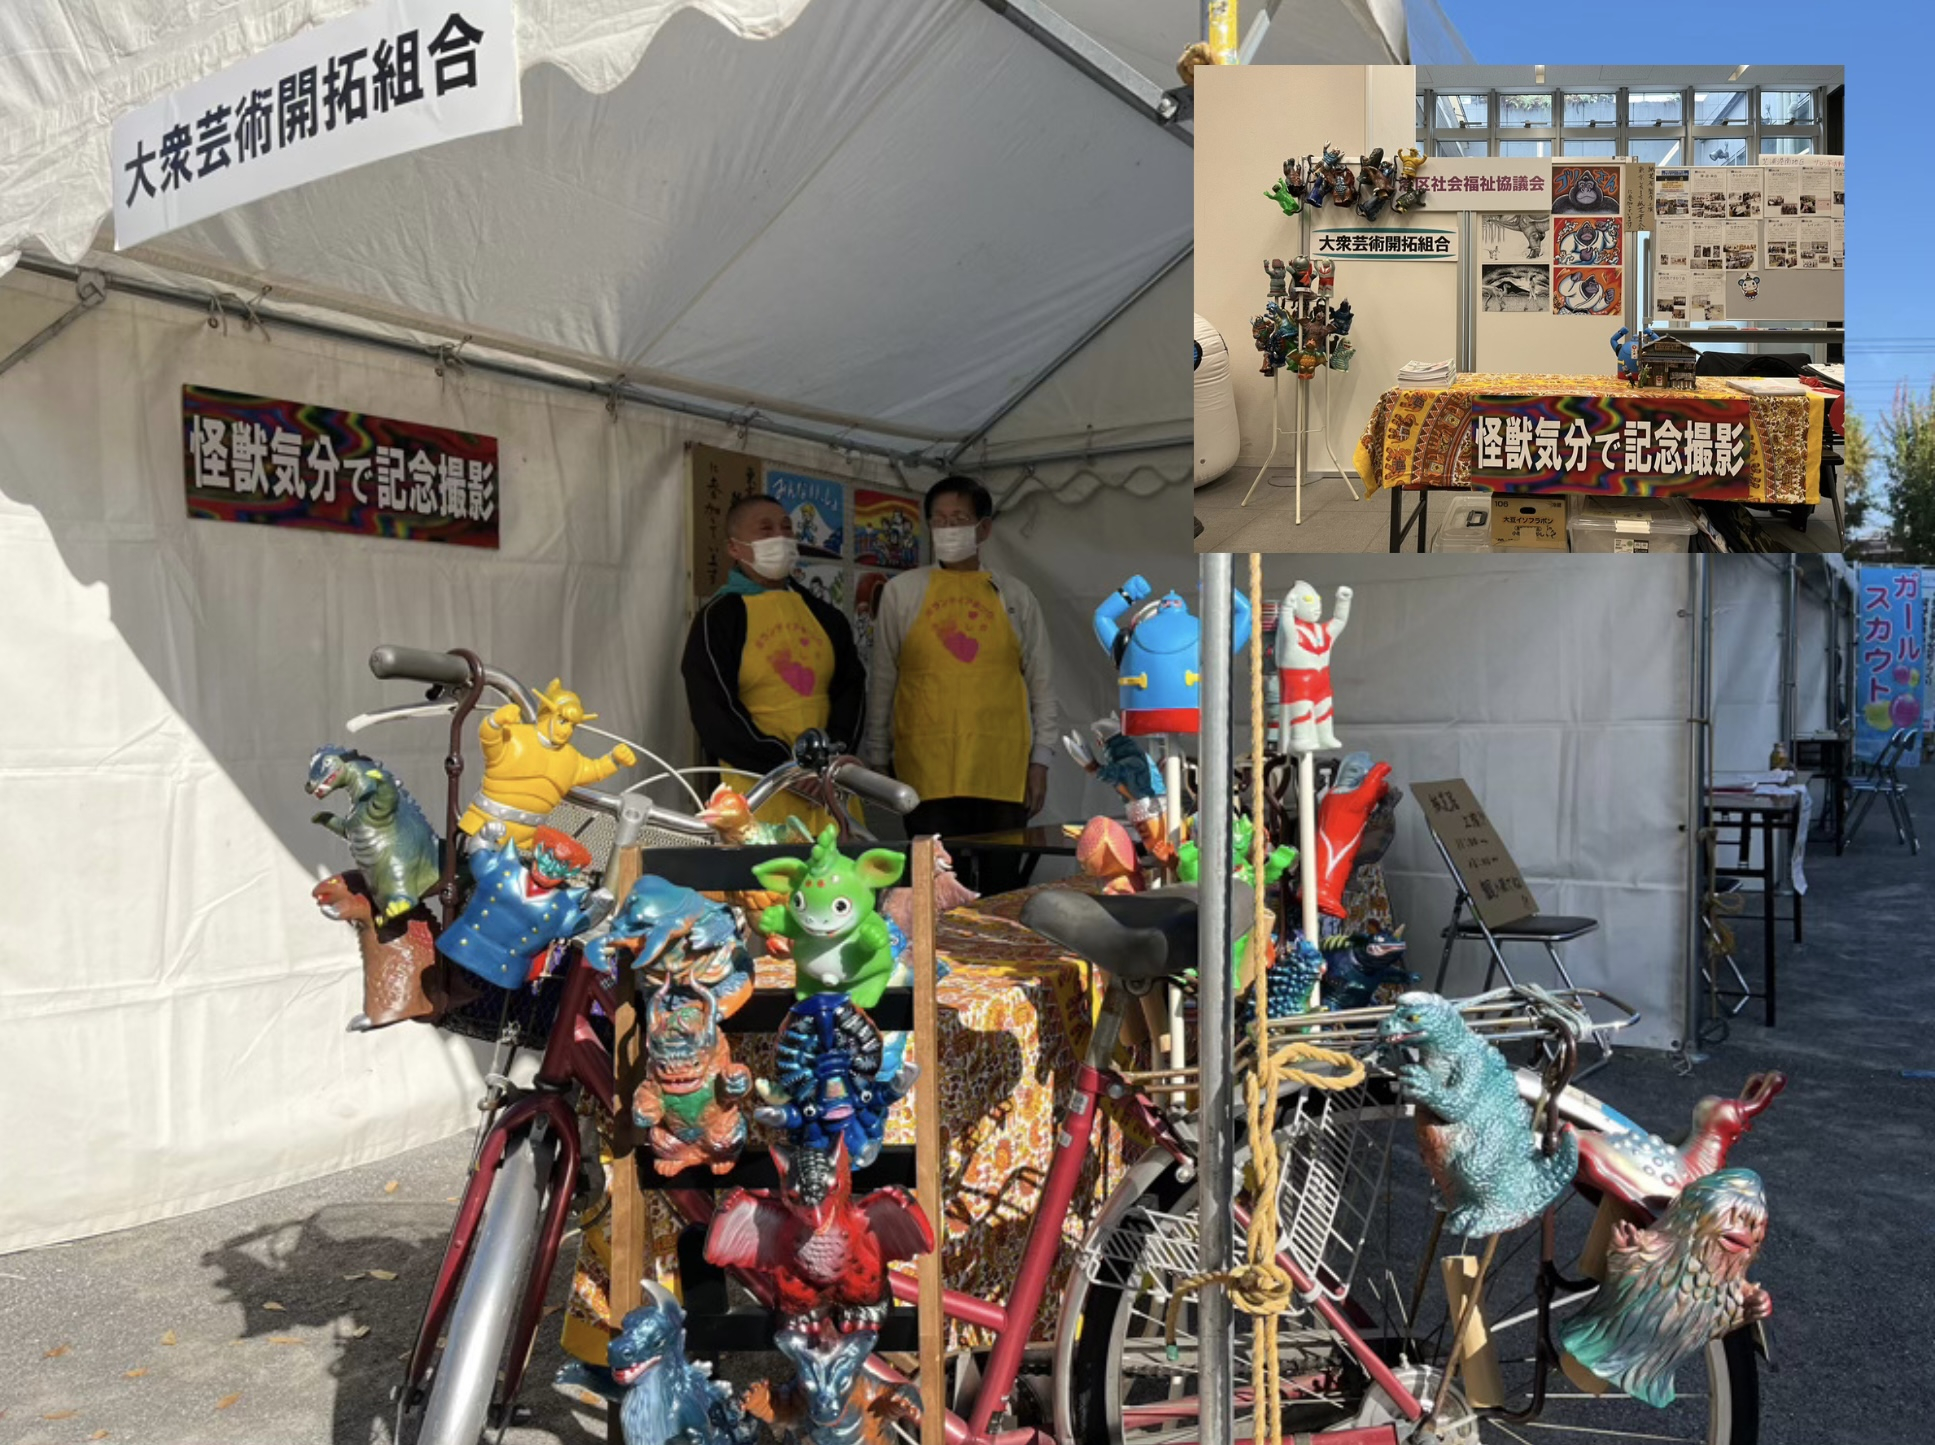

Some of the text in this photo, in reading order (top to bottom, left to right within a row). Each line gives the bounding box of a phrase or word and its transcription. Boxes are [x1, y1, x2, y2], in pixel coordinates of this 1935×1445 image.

[124, 13, 484, 207] 大衆芸術開拓組合
[1319, 235, 1451, 252] 大衆芸術開拓組合
[190, 415, 495, 521] 怪獣気分で記念撮影
[1475, 415, 1746, 477] 怪獣気分で記念撮影
[1503, 516, 1554, 525] 大豆イソフラボン
[1864, 586, 1893, 703] スカウト
[1894, 572, 1920, 662] ガール
